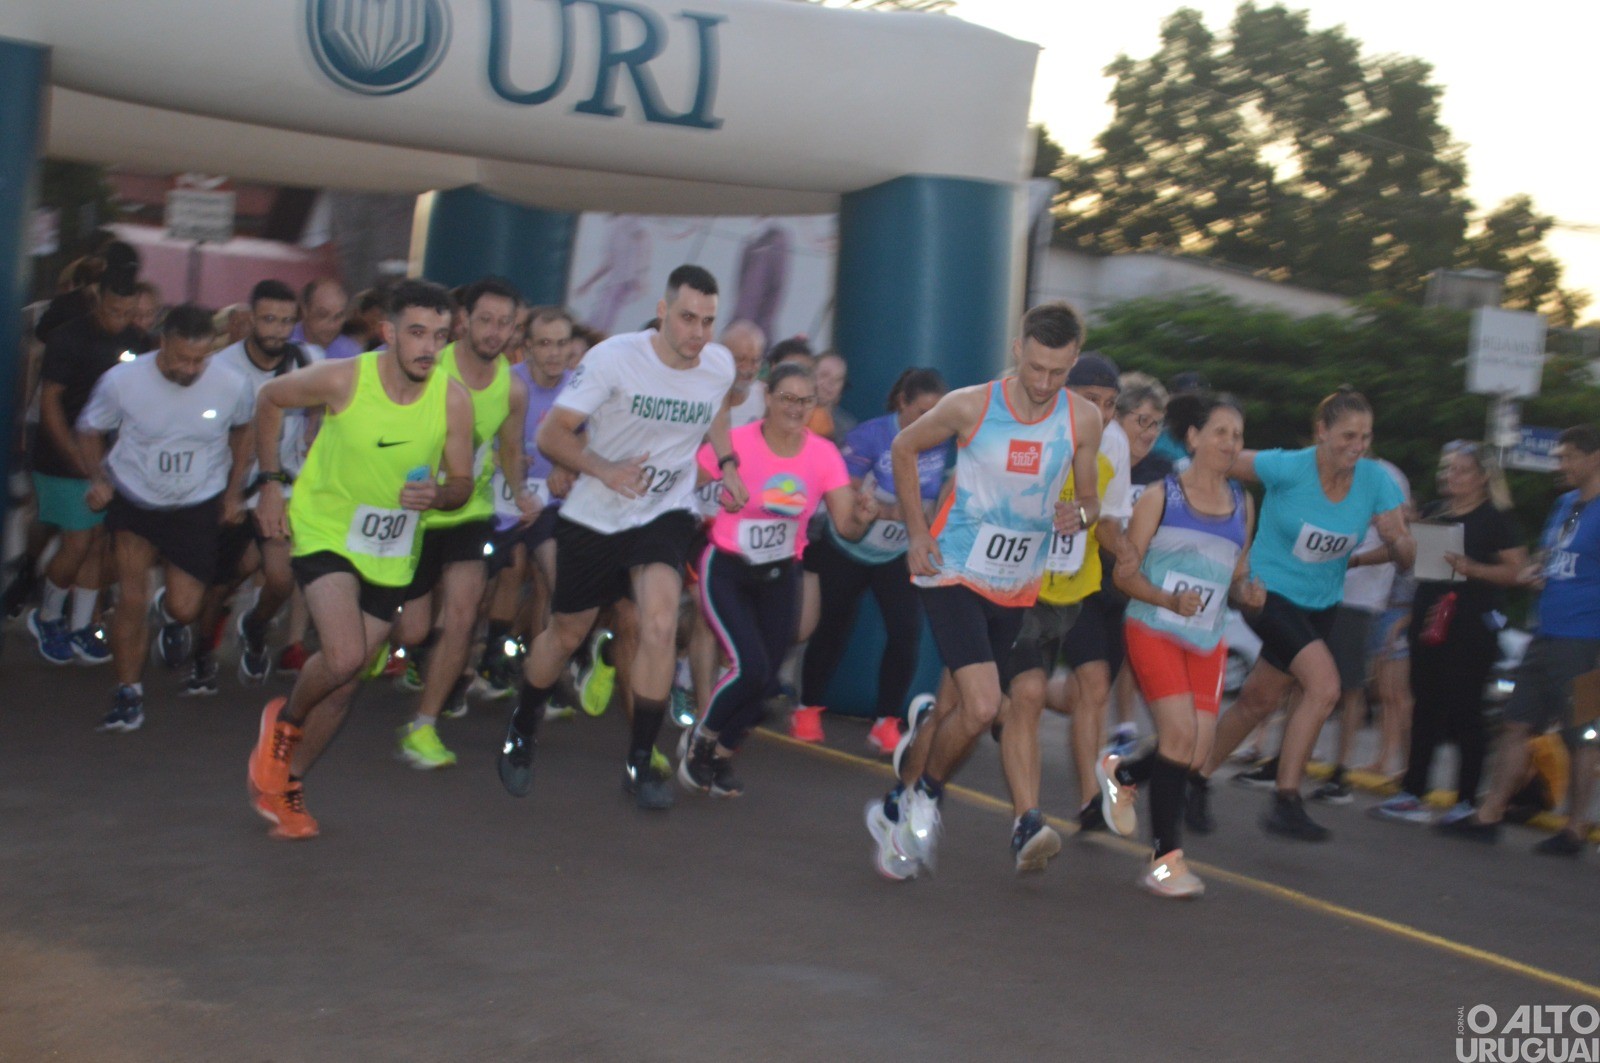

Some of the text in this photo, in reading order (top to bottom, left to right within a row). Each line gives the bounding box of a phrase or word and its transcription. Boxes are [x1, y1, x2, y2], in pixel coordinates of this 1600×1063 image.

[484, 0, 728, 129] URI
[631, 394, 713, 424] FISIOTERAPIA
[159, 451, 194, 473] 017
[502, 479, 540, 501] 07
[361, 513, 407, 540] 030
[749, 522, 787, 549] 023
[986, 533, 1032, 562] 015
[1306, 531, 1349, 553] 030
